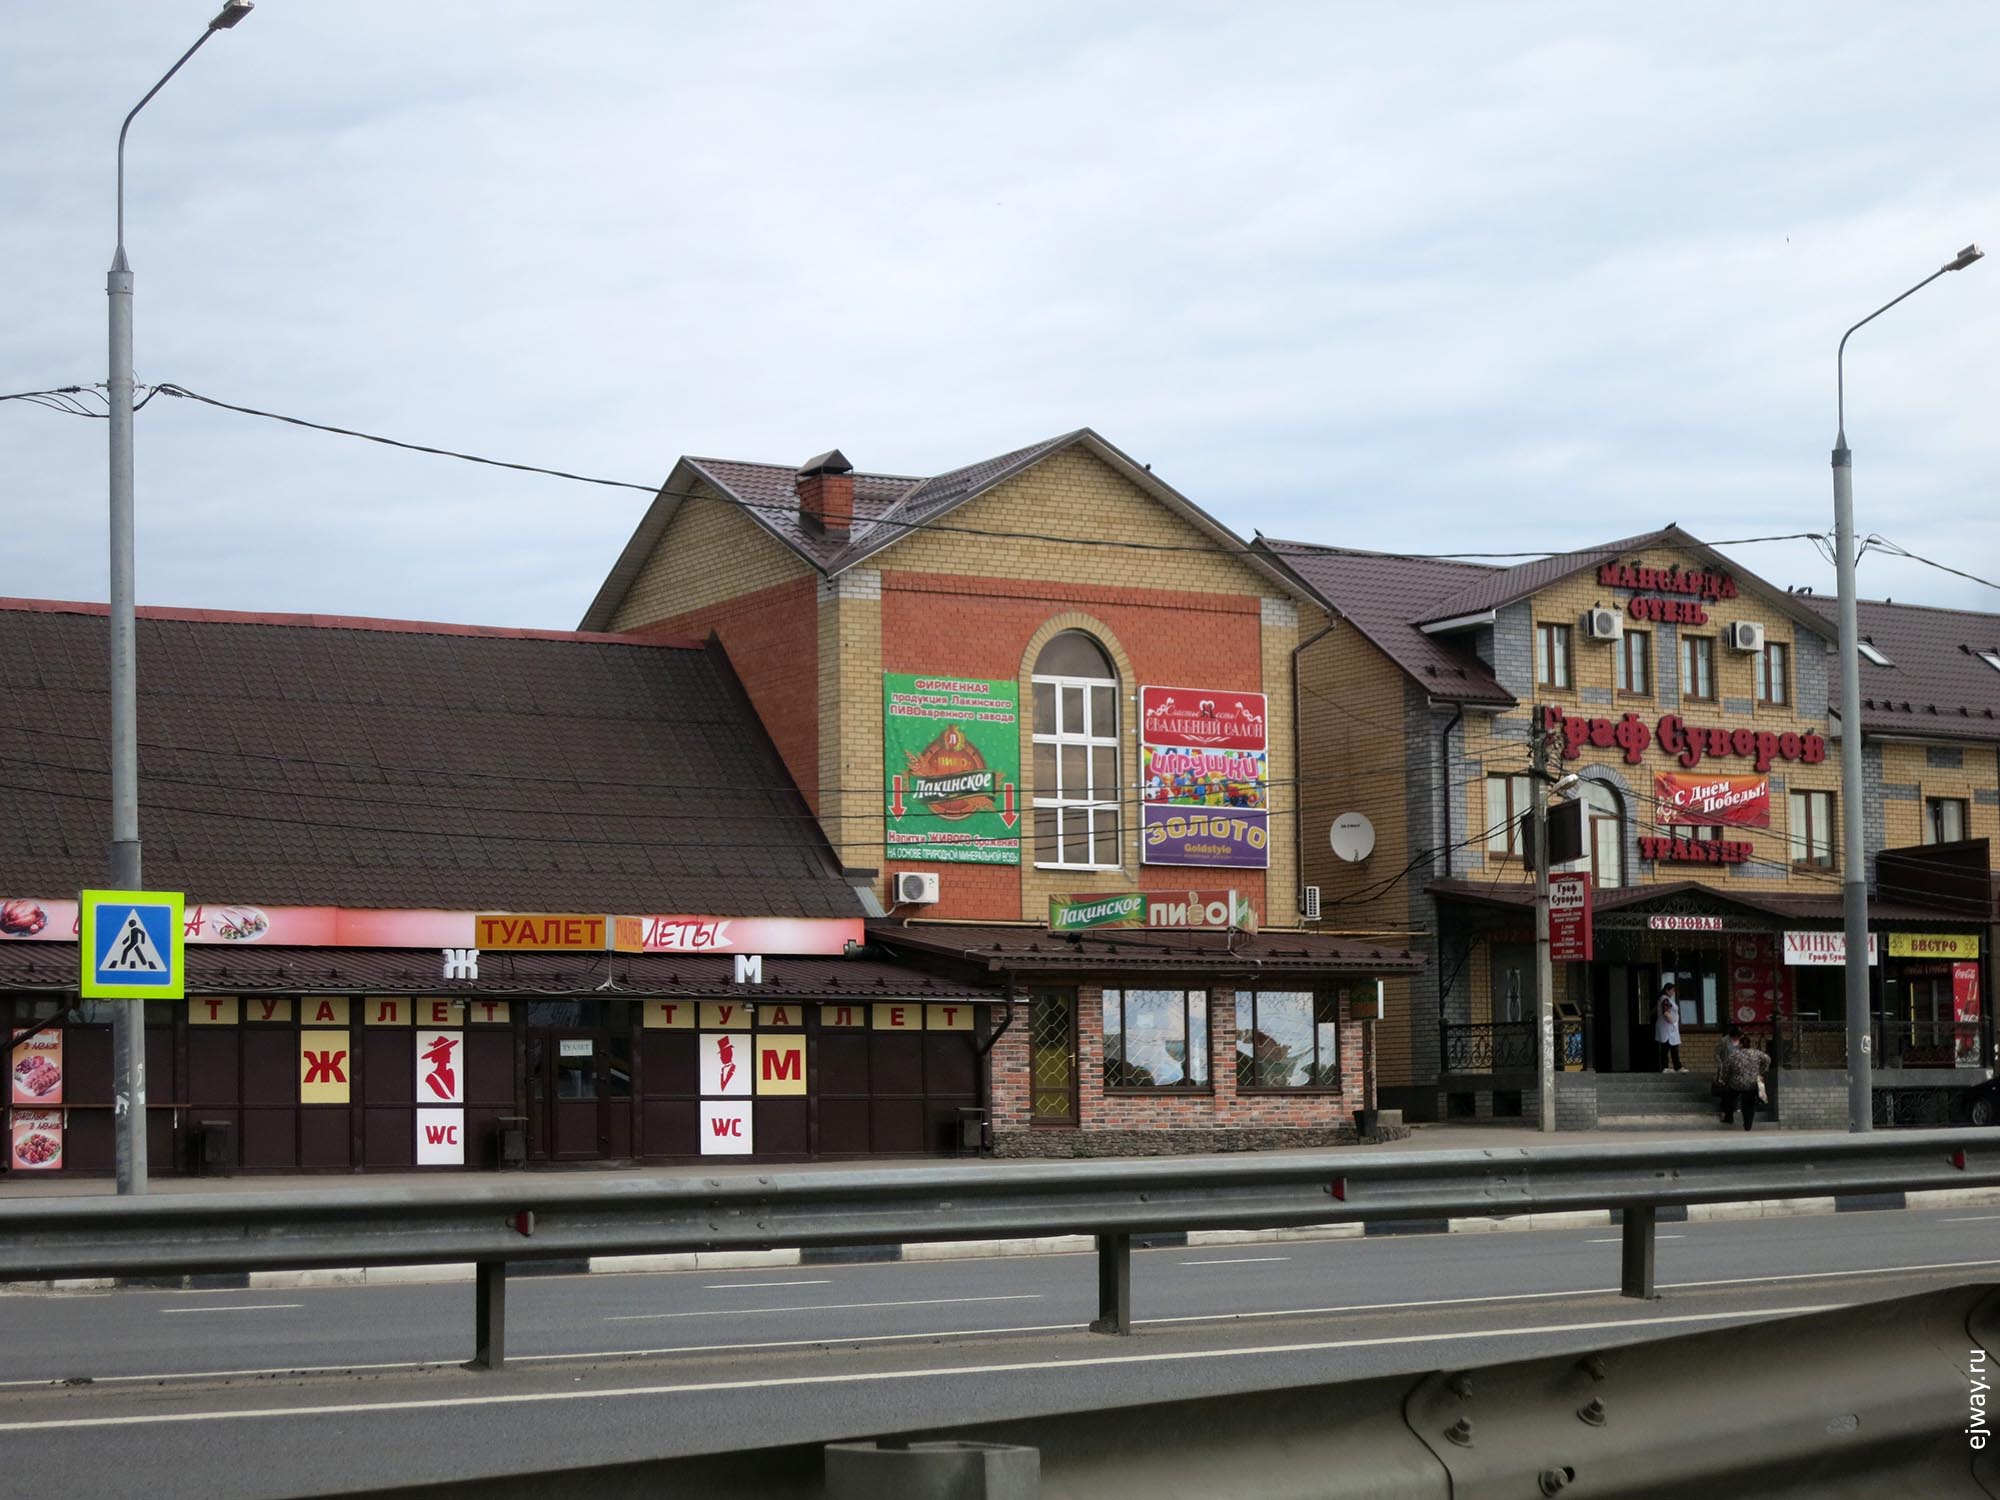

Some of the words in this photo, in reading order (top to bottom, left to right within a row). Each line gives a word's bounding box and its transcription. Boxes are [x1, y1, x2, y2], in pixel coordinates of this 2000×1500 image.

[1600, 565, 1738, 600] МАНСАРДА
[1630, 597, 1708, 625] ОТЕЛЬ
[915, 679, 989, 693] ФИРМЕННАЯ
[892, 693, 948, 706] продукция
[951, 696, 1013, 708] Лакинского
[890, 705, 975, 719] ПИВОваренного
[977, 712, 1015, 722] завода
[1145, 717, 1221, 735] СВАДЕБНЫЙ
[1224, 722, 1263, 738] САЛОН
[1545, 706, 1651, 763] Граф
[1657, 715, 1826, 772] Суворов
[914, 773, 991, 799] Лакинское
[1674, 789, 1686, 805] С
[1689, 781, 1731, 802] Днём
[1702, 782, 1766, 814] Победы!
[1147, 816, 1267, 849] ЗОЛОТО
[887, 848, 897, 857] НА
[897, 848, 922, 858] ОСНОВЕ
[922, 847, 958, 861] ПРИРОДНОЙ
[1639, 837, 1753, 862] ТРАКТИР
[1056, 897, 1142, 925] Лакинское
[1651, 916, 1722, 930] СТОЛОВАЯ
[481, 919, 603, 945] ТУАЛЕТ
[642, 917, 719, 947] ЛЕТЫ
[1787, 935, 1874, 952] ХИНКАИ
[1829, 952, 1846, 962] Суво
[1910, 939, 1958, 952] БИСТРО
[442, 948, 480, 980] Ж
[734, 954, 762, 984] М
[303, 1050, 347, 1084] Ж
[761, 1049, 802, 1081] М
[425, 1124, 458, 1145] WC
[711, 1117, 743, 1138] WC
